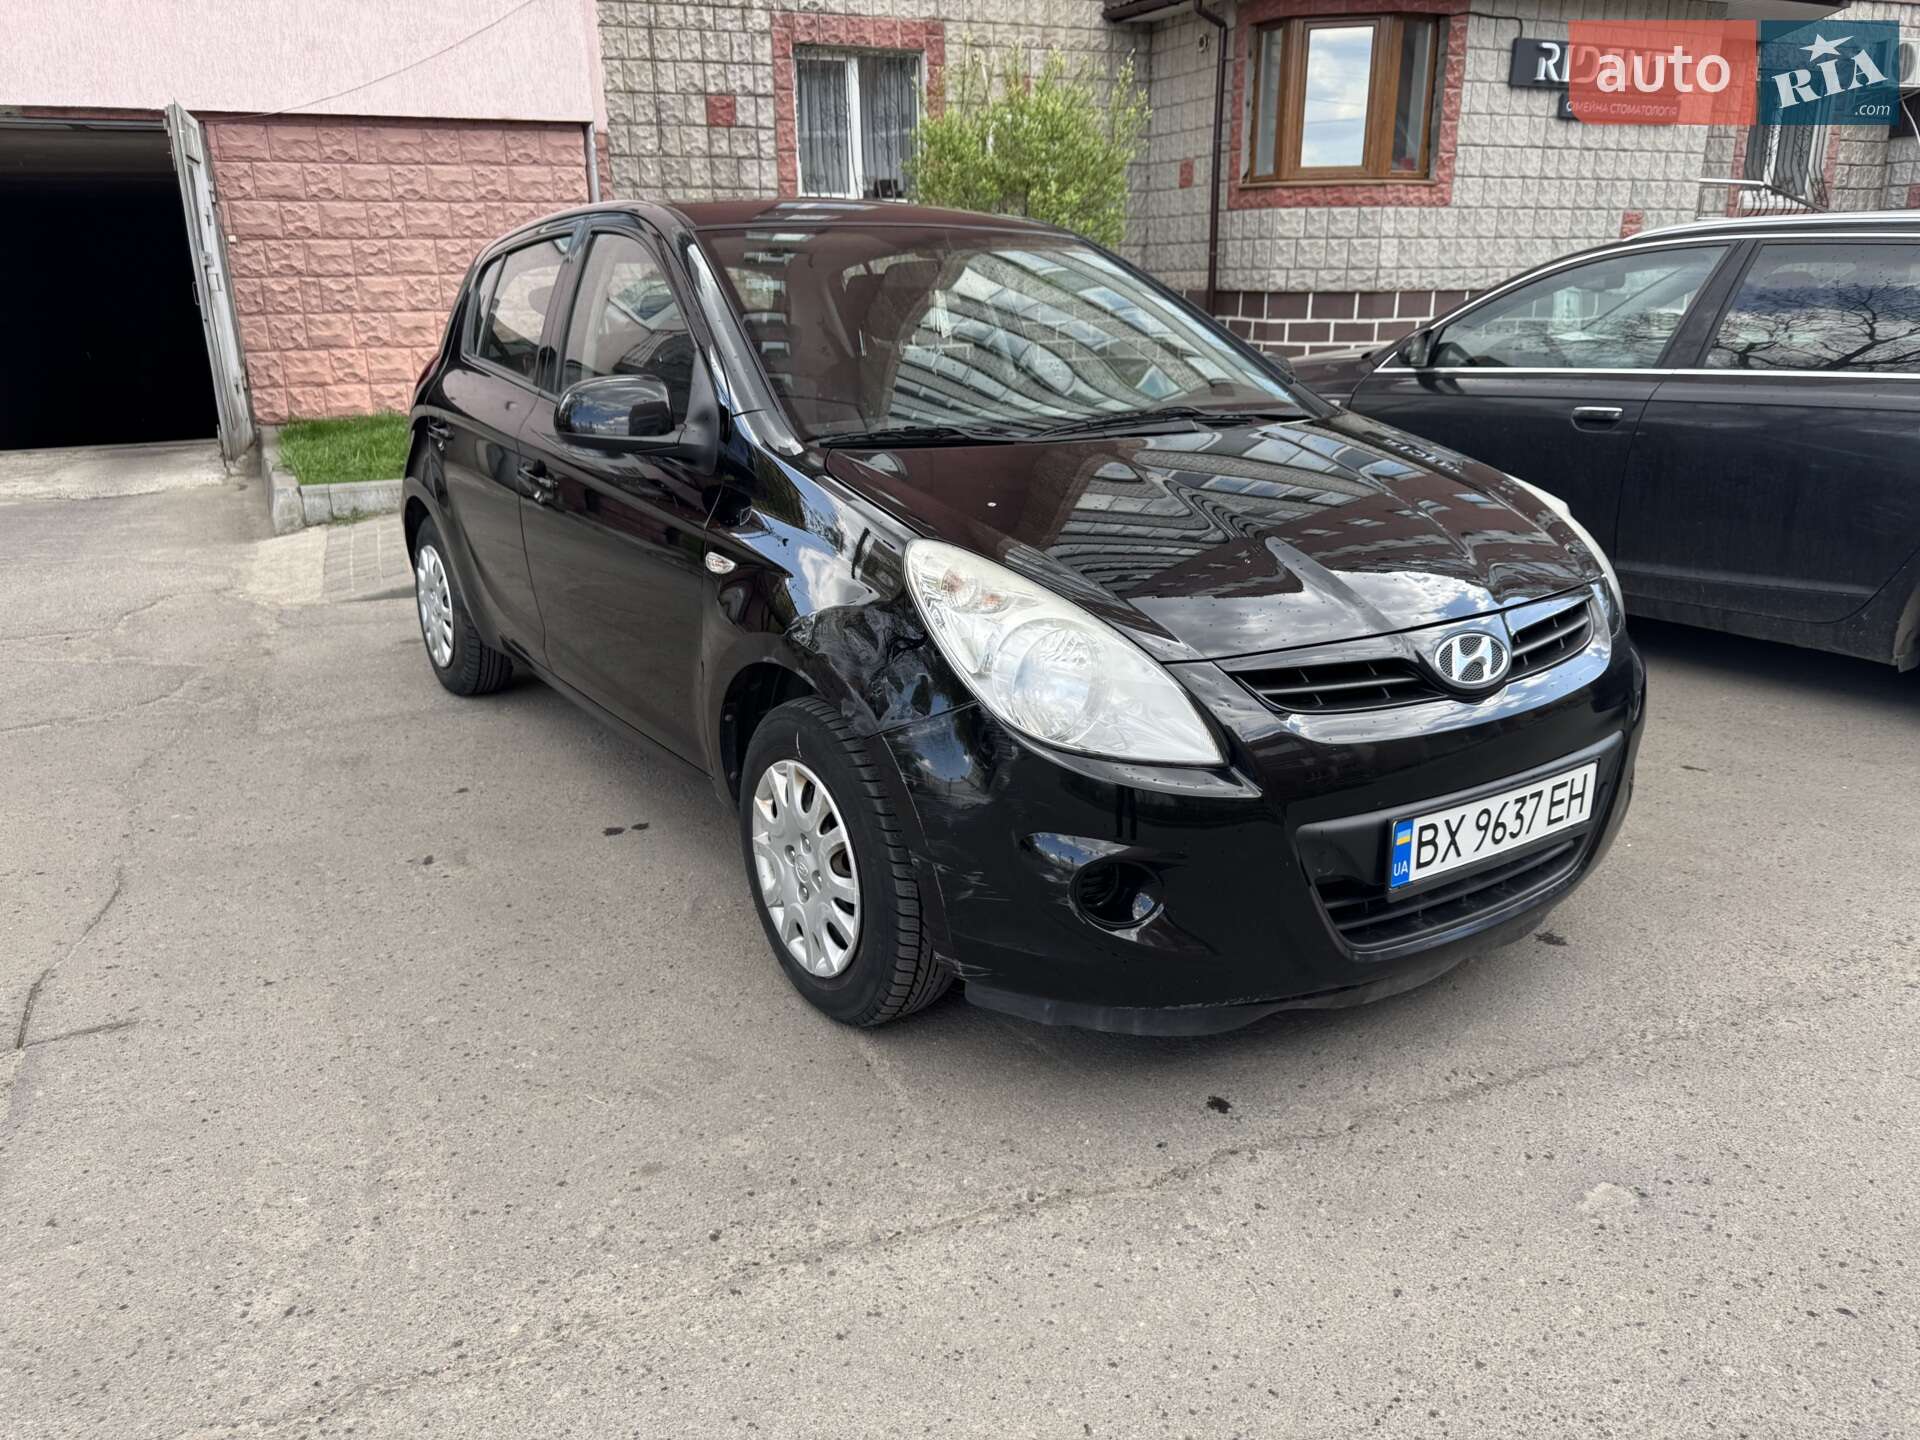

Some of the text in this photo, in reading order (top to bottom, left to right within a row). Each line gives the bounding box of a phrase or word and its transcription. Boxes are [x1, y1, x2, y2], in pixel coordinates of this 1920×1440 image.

[1610, 103, 1678, 117] СТОМАТОЛОГІЯ
[1415, 773, 1589, 870] BX 9637 EH
[1393, 860, 1409, 876] UA
